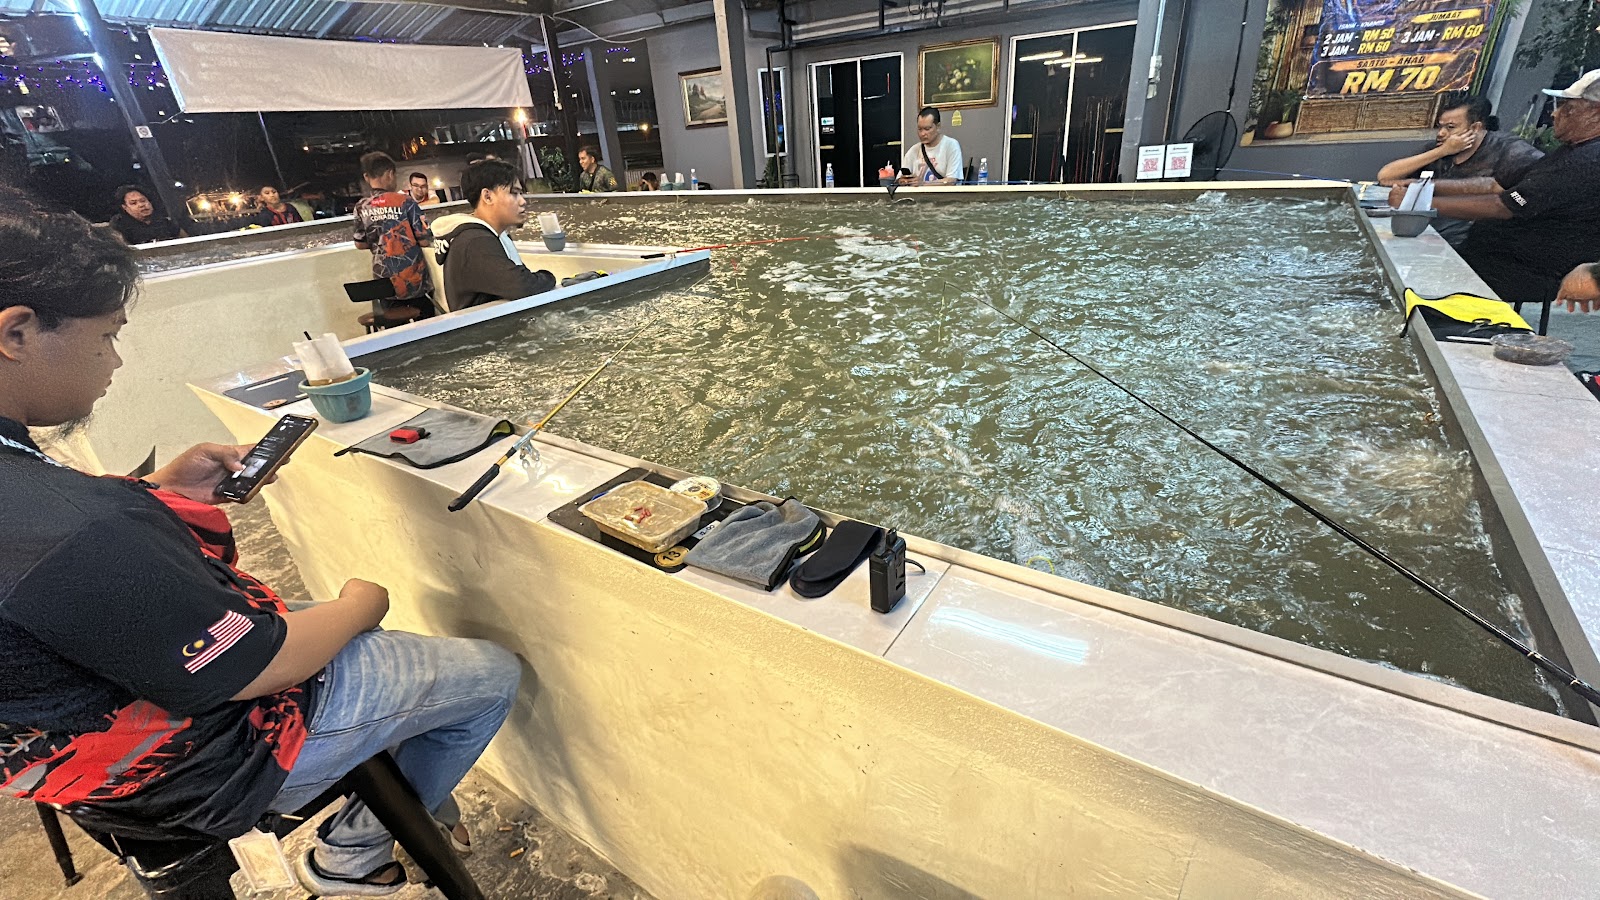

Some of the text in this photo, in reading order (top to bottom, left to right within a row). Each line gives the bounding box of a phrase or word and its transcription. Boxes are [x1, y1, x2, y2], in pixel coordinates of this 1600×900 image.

[1428, 11, 1462, 20] JUMAAT
[1323, 33, 1332, 44] 2
[1331, 32, 1354, 43] JAM
[1362, 29, 1381, 41] RM
[1379, 27, 1396, 40] 50
[1401, 31, 1412, 43] 3
[1410, 29, 1436, 43] JAM
[1441, 24, 1466, 41] RM
[1464, 23, 1485, 39] 60
[1321, 46, 1330, 57] 3
[1328, 44, 1350, 57] JAM
[1357, 42, 1376, 55] RM
[1375, 41, 1391, 53] 60
[1356, 58, 1387, 69] SABTU
[1396, 55, 1426, 65] AHAD
[1340, 65, 1441, 94] RM 70
[662, 550, 681, 561] 13
